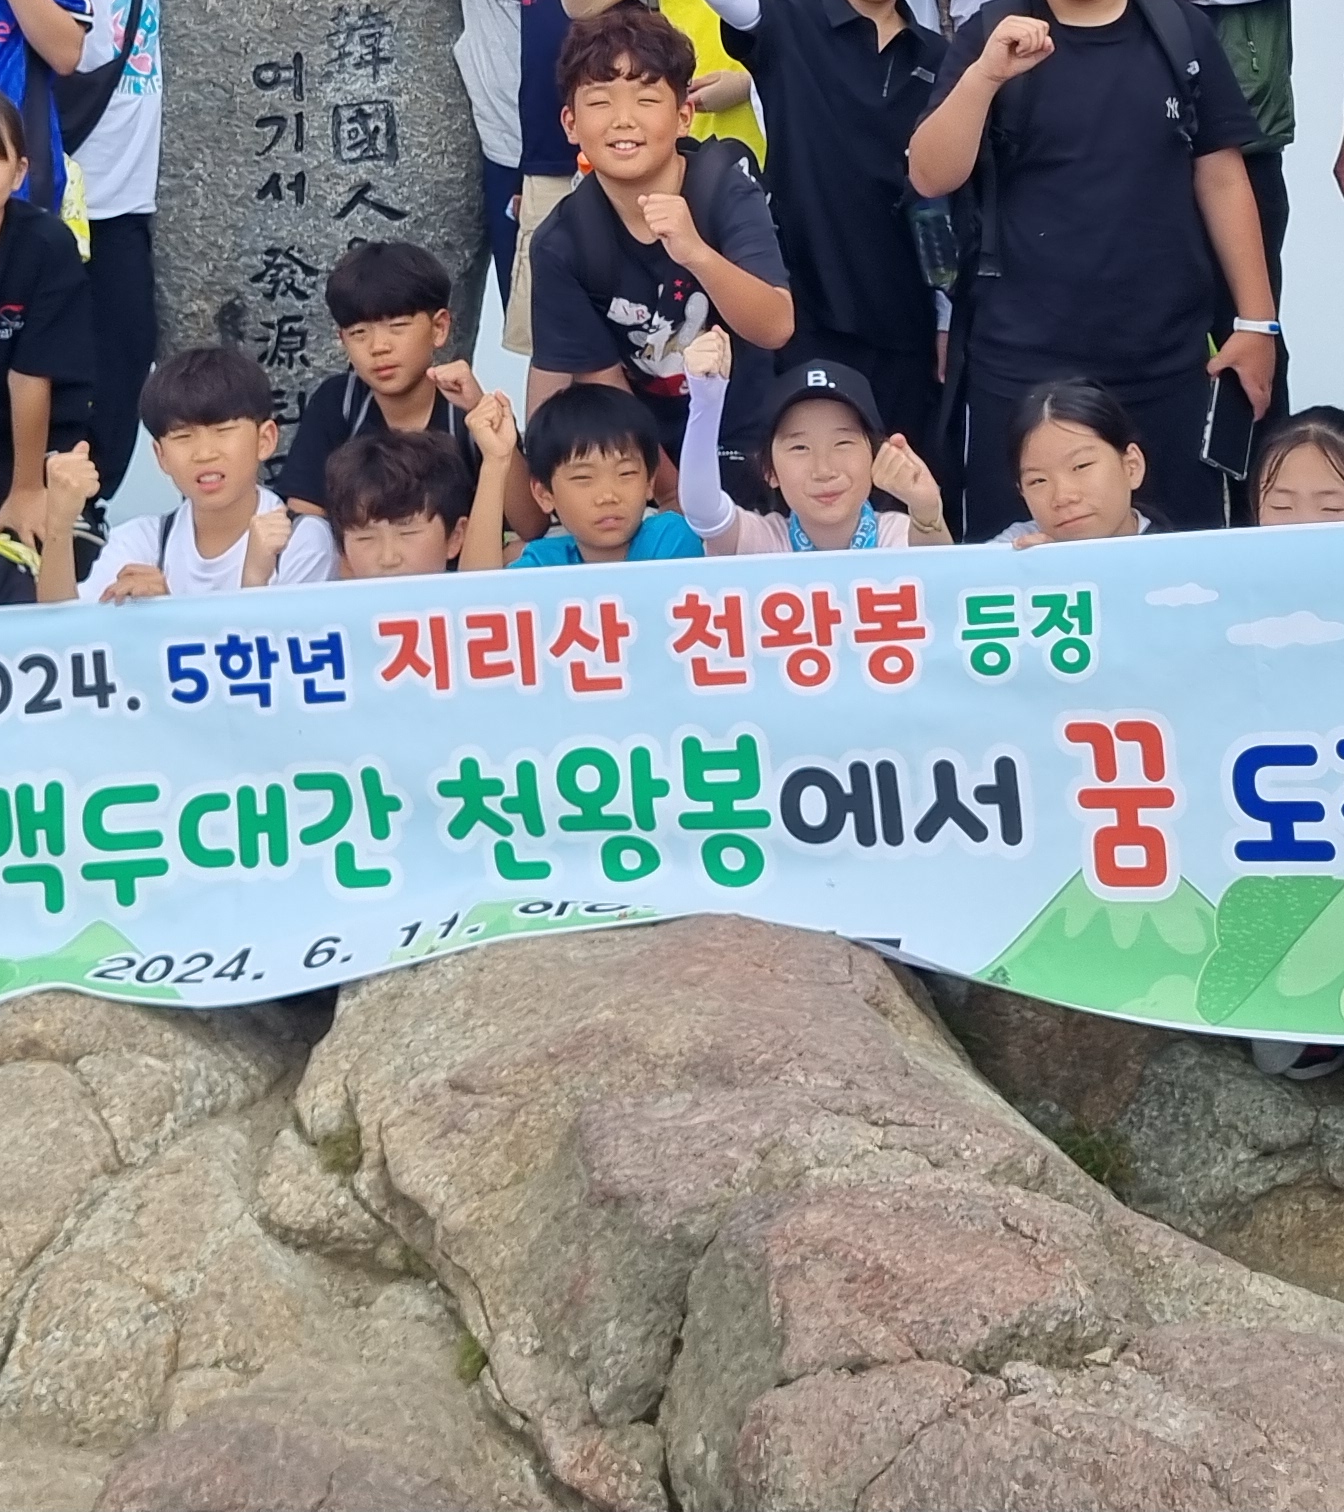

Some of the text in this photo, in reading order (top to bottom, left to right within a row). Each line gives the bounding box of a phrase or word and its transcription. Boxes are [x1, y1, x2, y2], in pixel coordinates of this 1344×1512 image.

[253, 51, 306, 206] 여기서
[324, 4, 408, 250] 韓國人
[167, 632, 346, 708] 5학년
[378, 602, 631, 693] 지리산
[672, 584, 927, 688] 천왕봉
[961, 590, 1094, 677] 등정
[436, 733, 1024, 889] 천왕봉에서
[1064, 719, 1176, 889] 꿈
[90, 947, 266, 986] 2024.
[303, 936, 354, 970] 6.
